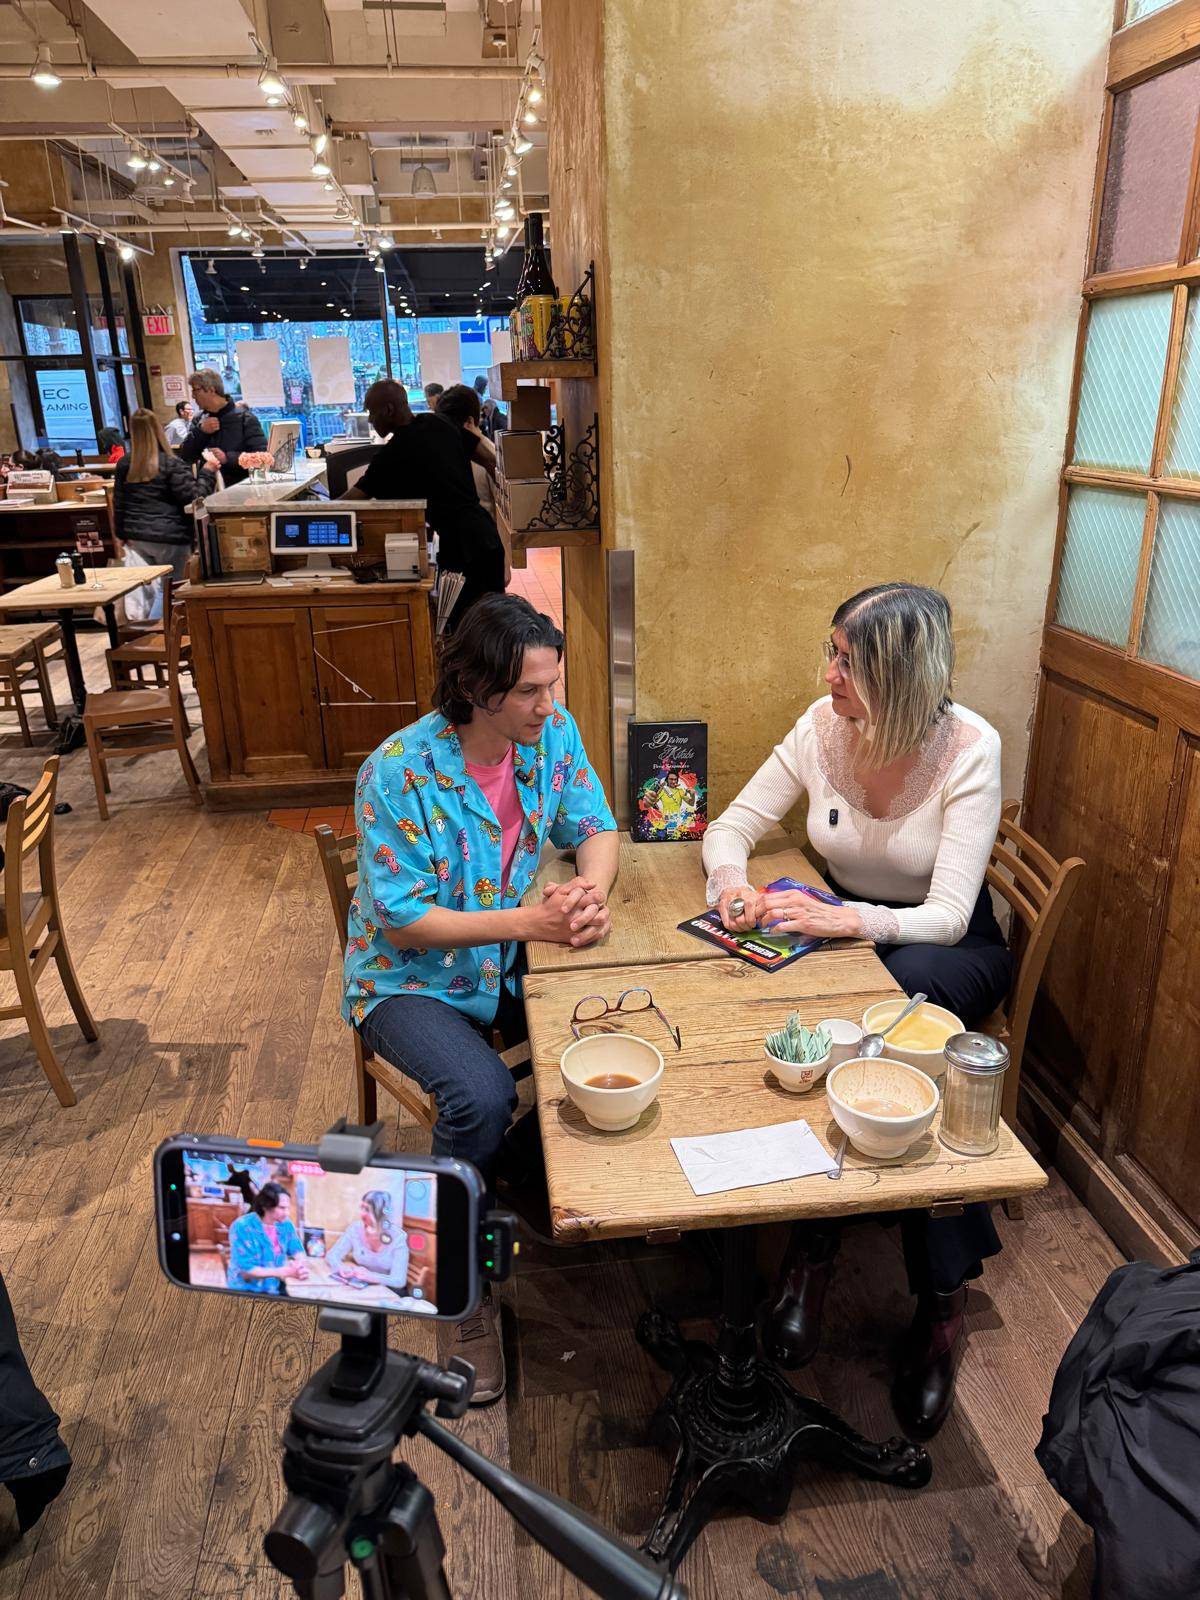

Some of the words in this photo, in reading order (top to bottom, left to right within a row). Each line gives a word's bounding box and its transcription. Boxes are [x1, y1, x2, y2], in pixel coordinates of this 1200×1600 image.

[146, 316, 169, 334] EXIT
[43, 388, 70, 400] EC
[43, 403, 88, 412] AMING
[691, 919, 739, 943] TATTOO
